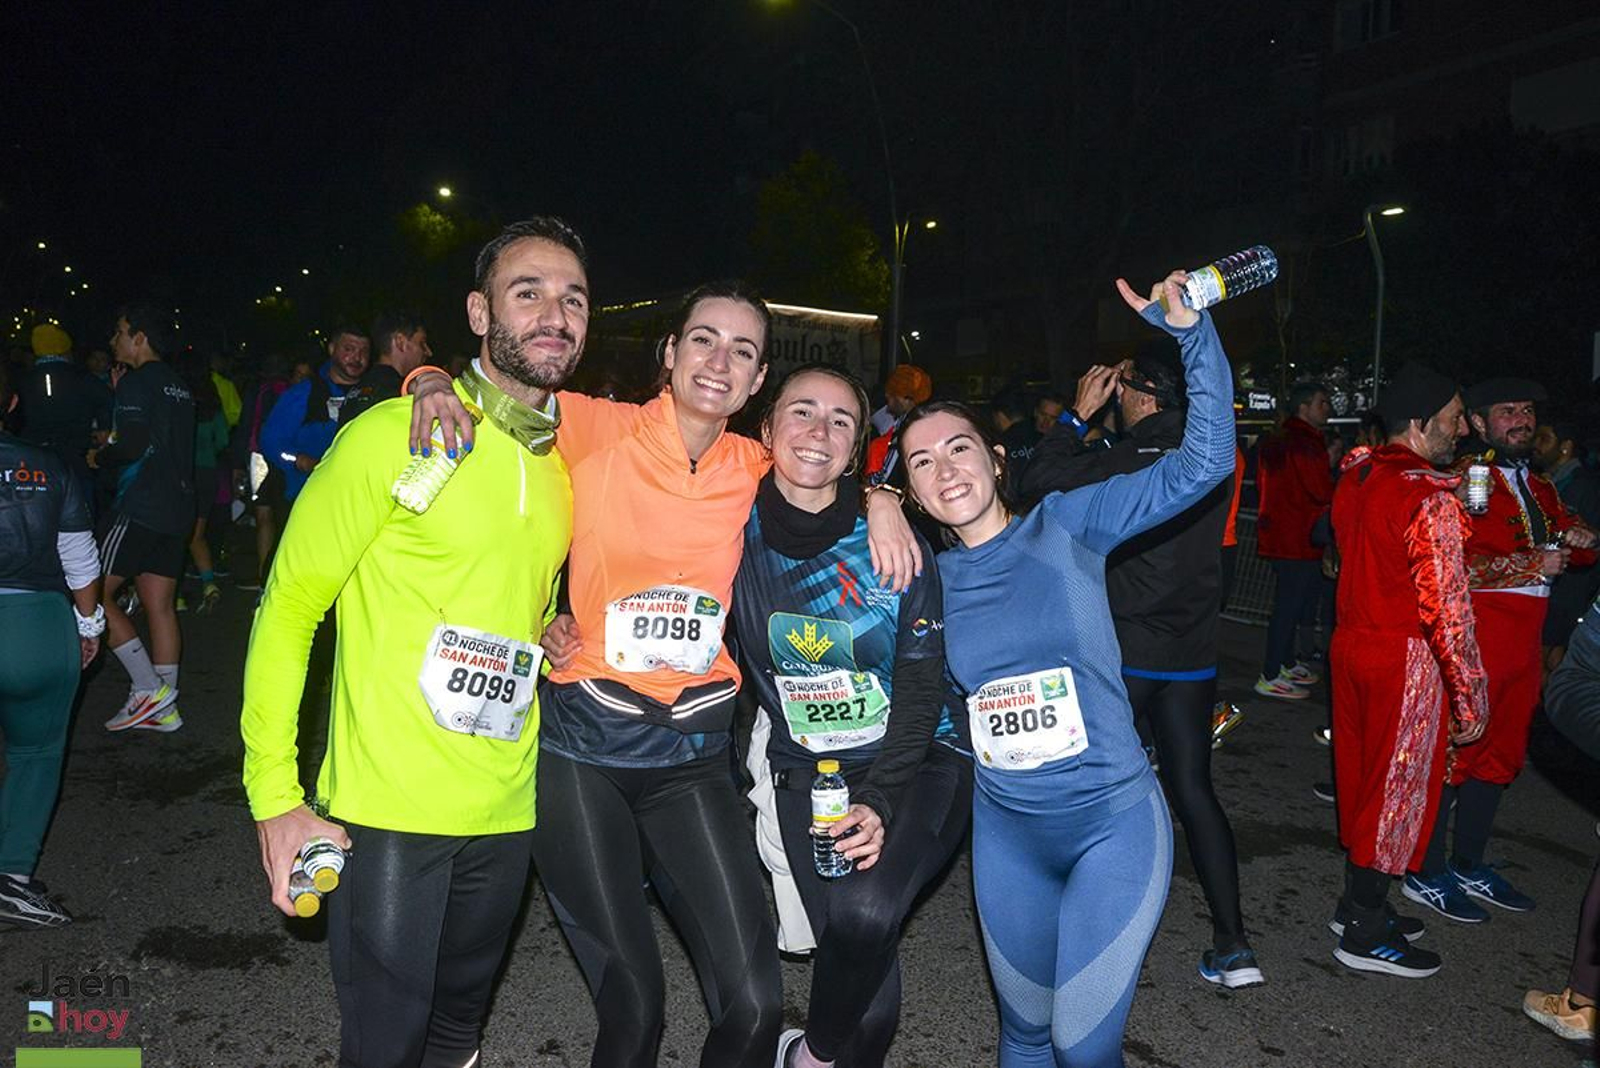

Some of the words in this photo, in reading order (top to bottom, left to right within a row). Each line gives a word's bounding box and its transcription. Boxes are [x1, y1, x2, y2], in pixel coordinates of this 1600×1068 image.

[632, 591, 673, 601] NOCHE
[674, 592, 690, 602] DE
[619, 602, 645, 612] SAN
[647, 600, 688, 614] ANTÓN
[632, 616, 701, 641] 8098
[458, 639, 497, 657] NOCHE
[495, 648, 510, 660] DE
[440, 648, 469, 663] SAN
[469, 655, 508, 672] ANTÓN
[447, 667, 517, 704] 8099
[796, 681, 830, 692] NOCHE
[831, 679, 846, 691] DE
[986, 686, 1017, 698] NOCHE
[1018, 681, 1033, 693] DE
[789, 692, 811, 703] SAN
[977, 701, 996, 713] SAN
[996, 694, 1036, 709] ANTÓN
[805, 697, 866, 723] 2227
[989, 704, 1058, 737] 2806
